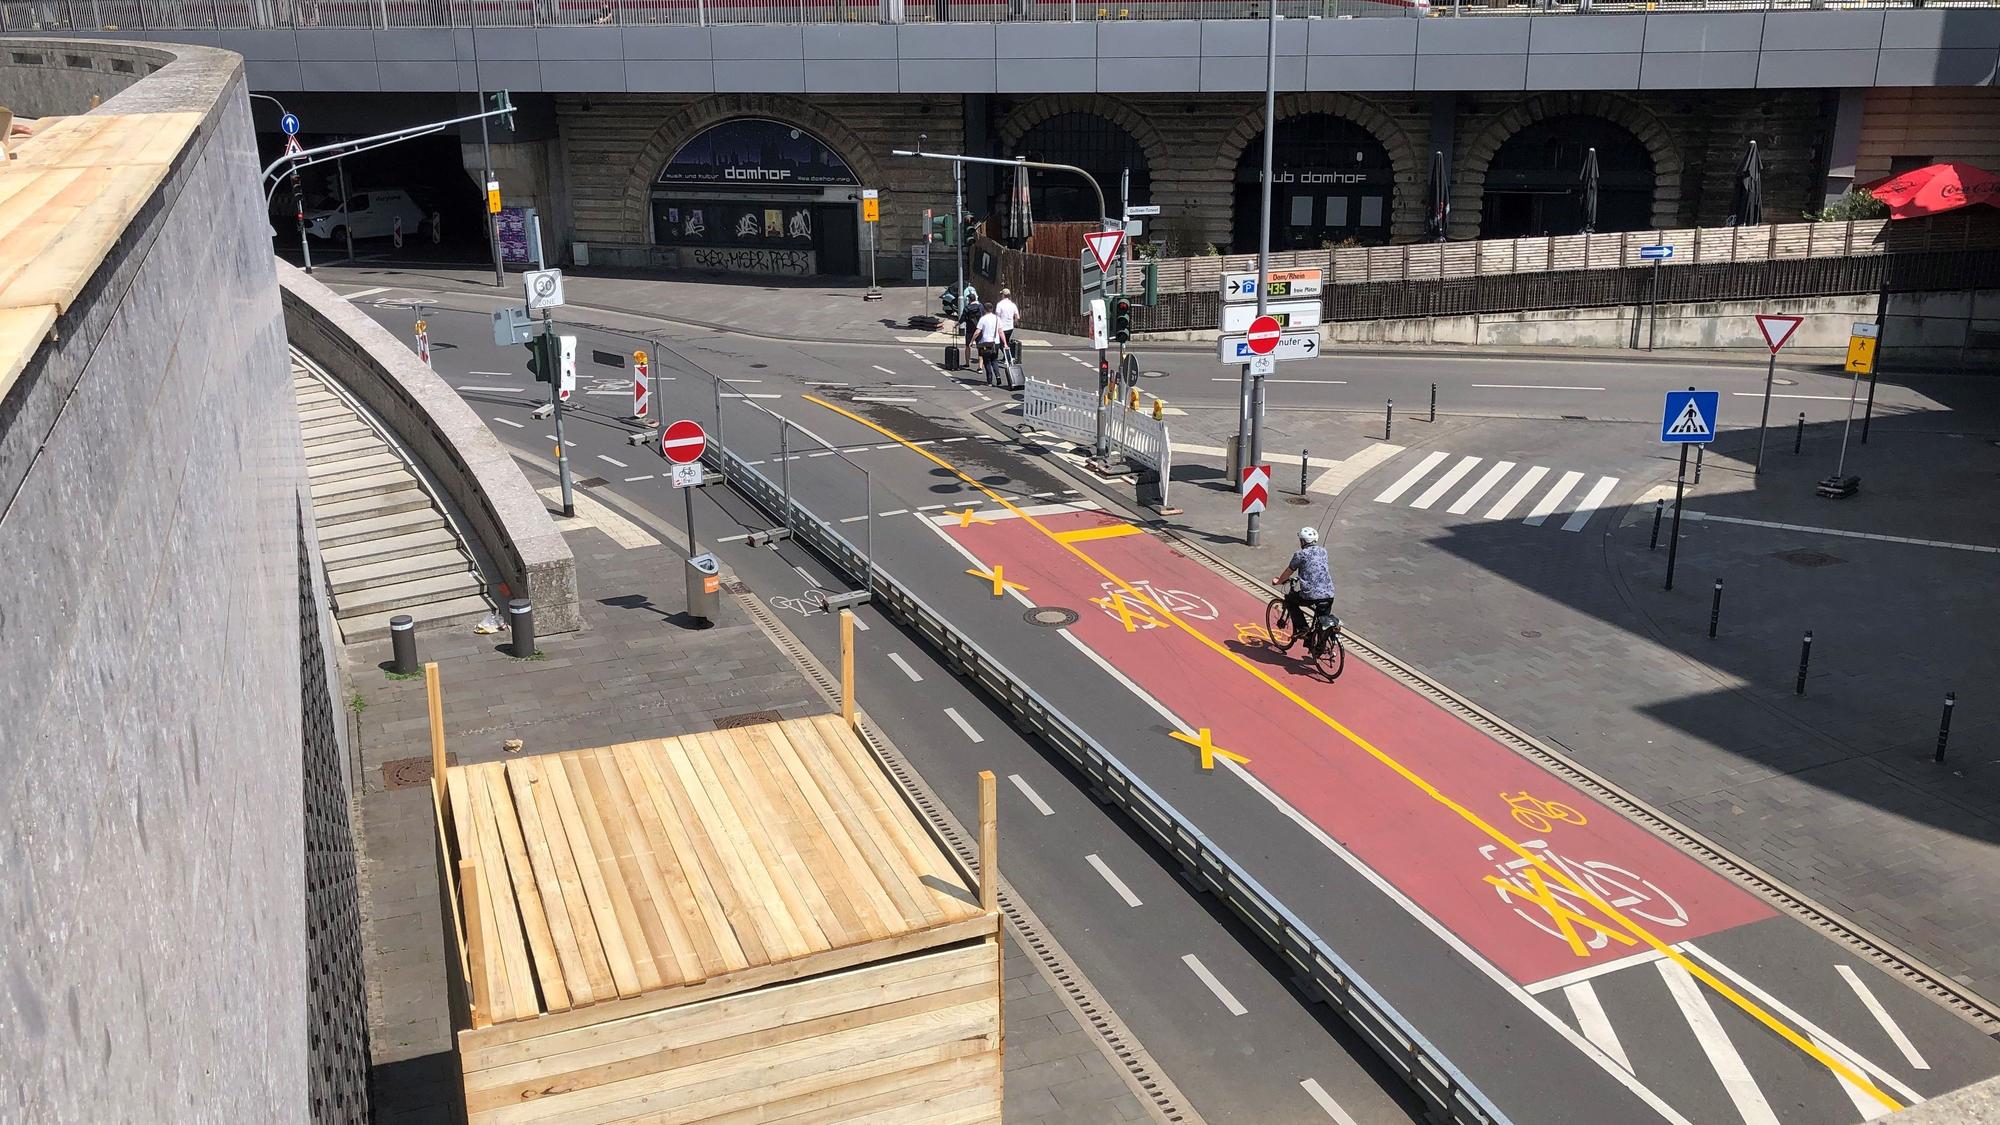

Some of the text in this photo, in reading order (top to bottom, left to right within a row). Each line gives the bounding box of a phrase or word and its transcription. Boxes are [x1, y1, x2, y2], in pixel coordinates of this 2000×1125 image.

[725, 166, 791, 180] domhof
[1259, 170, 1367, 184] kub domhof
[1273, 273, 1305, 281] Dom/Rhein
[538, 280, 552, 292] 30
[1245, 284, 1252, 293] P
[1267, 283, 1286, 295] 435
[539, 298, 555, 306] ZONE
[1279, 338, 1301, 346] nufer
